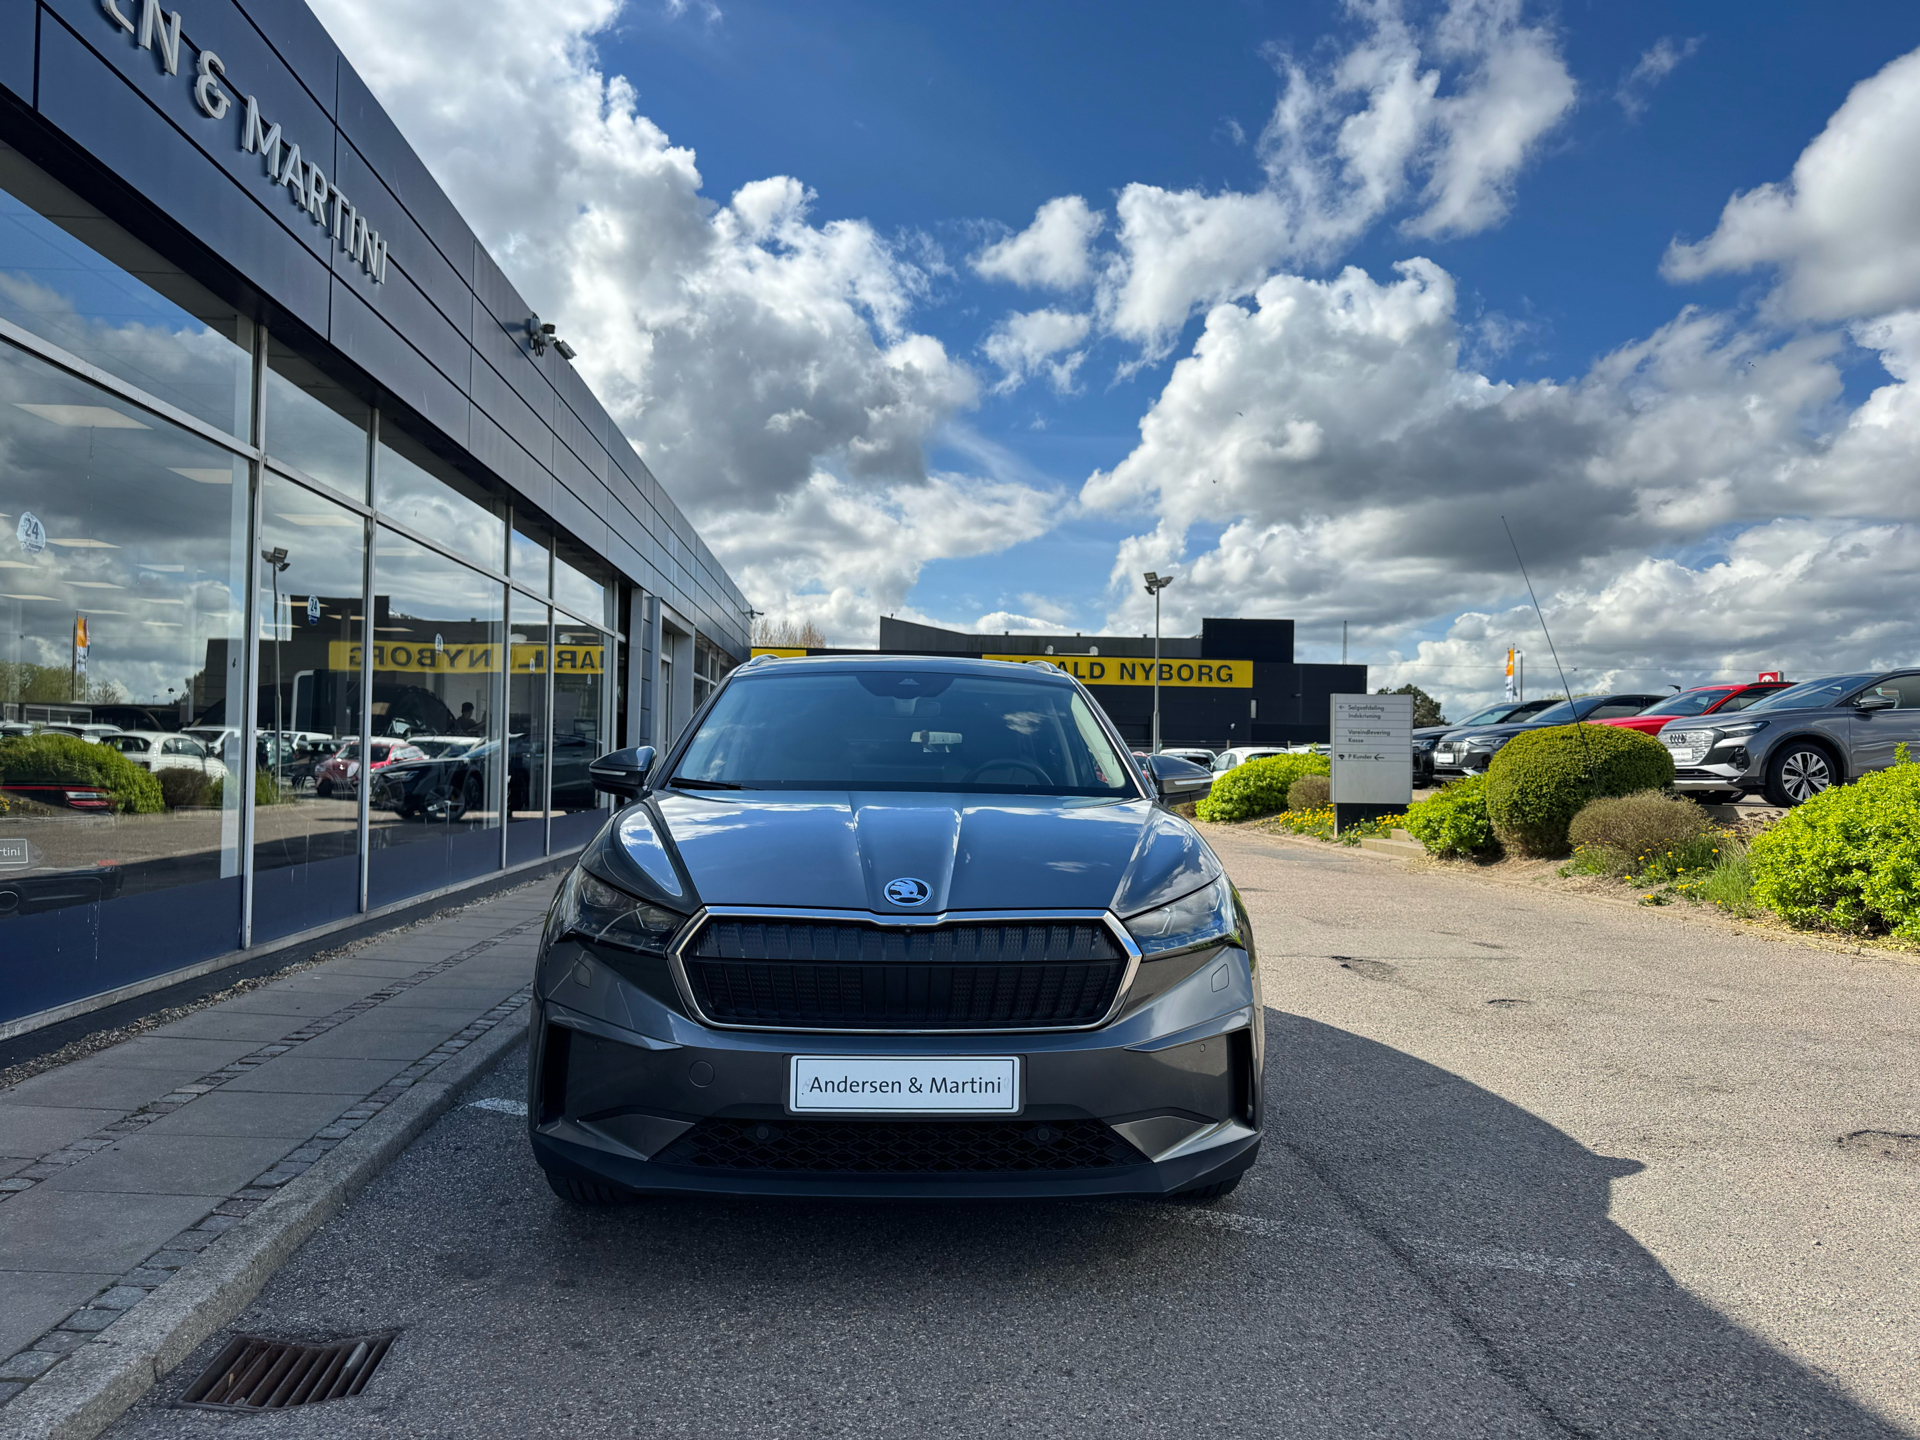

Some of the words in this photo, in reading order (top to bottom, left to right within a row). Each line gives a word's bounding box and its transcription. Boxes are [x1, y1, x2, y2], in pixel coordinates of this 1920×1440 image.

[194, 50, 231, 120] &
[241, 95, 388, 285] MARTINI
[1119, 662, 1234, 683] NYBORG
[1347, 704, 1385, 712] Salgsafdeling
[1347, 729, 1391, 737] Vareindlevering
[809, 1076, 902, 1093] Andersen
[908, 1077, 923, 1094] &
[929, 1077, 1001, 1094] Martini
